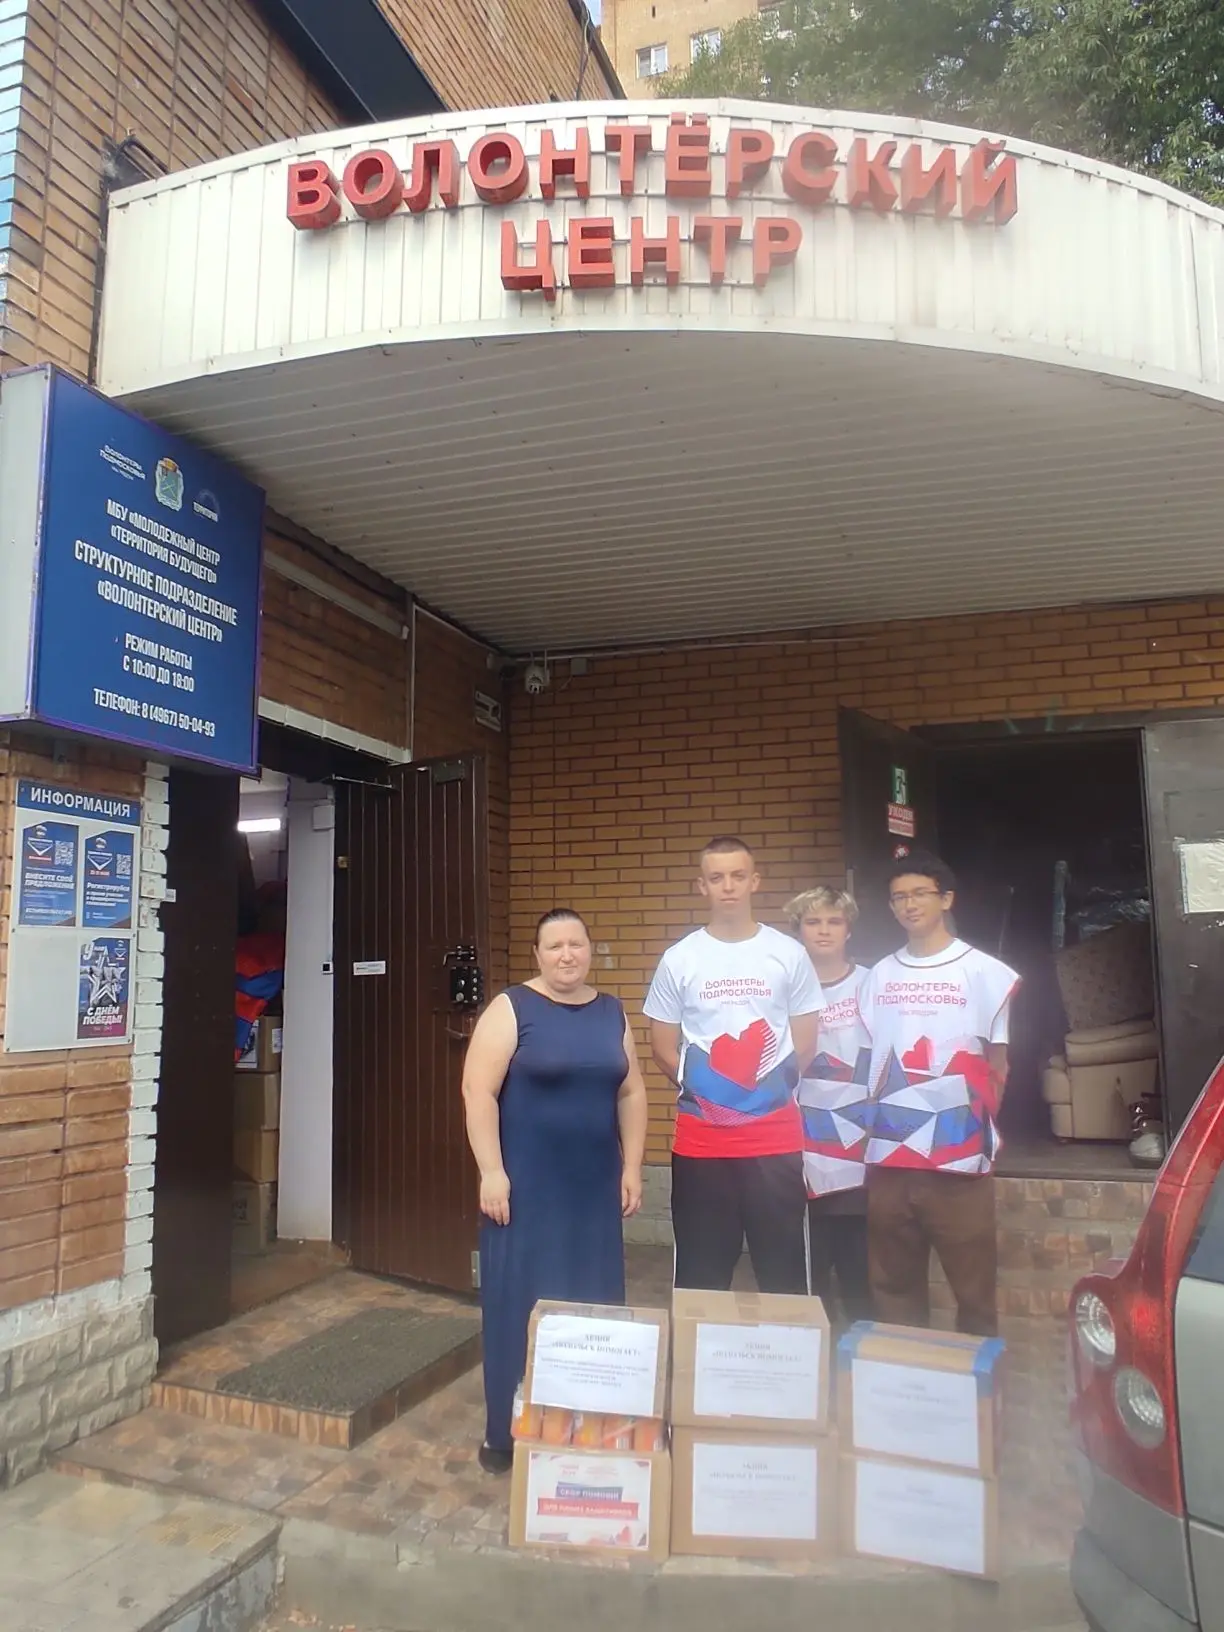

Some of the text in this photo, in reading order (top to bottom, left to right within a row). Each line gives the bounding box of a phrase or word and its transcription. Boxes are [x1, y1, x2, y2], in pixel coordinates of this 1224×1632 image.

[287, 112, 1018, 230] ВОЛОНТЁРСКИЙ
[500, 215, 804, 302] ЦЕНТР
[107, 498, 129, 520] МБУ
[196, 541, 221, 566] ЦЕНТР
[111, 524, 217, 583] «ТЕРРИТОРИЯ БУДУЩЕГО»
[75, 539, 238, 625] СТРУКТУРНОЕ ПОДРАЗДЕЛЕНИЕ
[97, 579, 223, 642] «ВОЛОНТЕРСКИЙ ЦЕНТР»
[125, 632, 193, 670] РЕЖИМ РАБОТЫ
[123, 655, 194, 692] С 10:00 ДО 18:00
[93, 688, 215, 737] ТЕЛЕФОН: 8 (4967) 50-04-93
[30, 786, 131, 818] ИНФОРМАЦИЯ
[699, 988, 772, 1002] ПОДМОСКОВЬЯ
[705, 978, 764, 990] ВОЛОНТЕРЫ
[877, 993, 968, 1009] ПОДМОСКОВЬЯ
[886, 981, 961, 994] ВОЛОНТЕРЫ
[87, 1004, 120, 1016] С ДНЁМ
